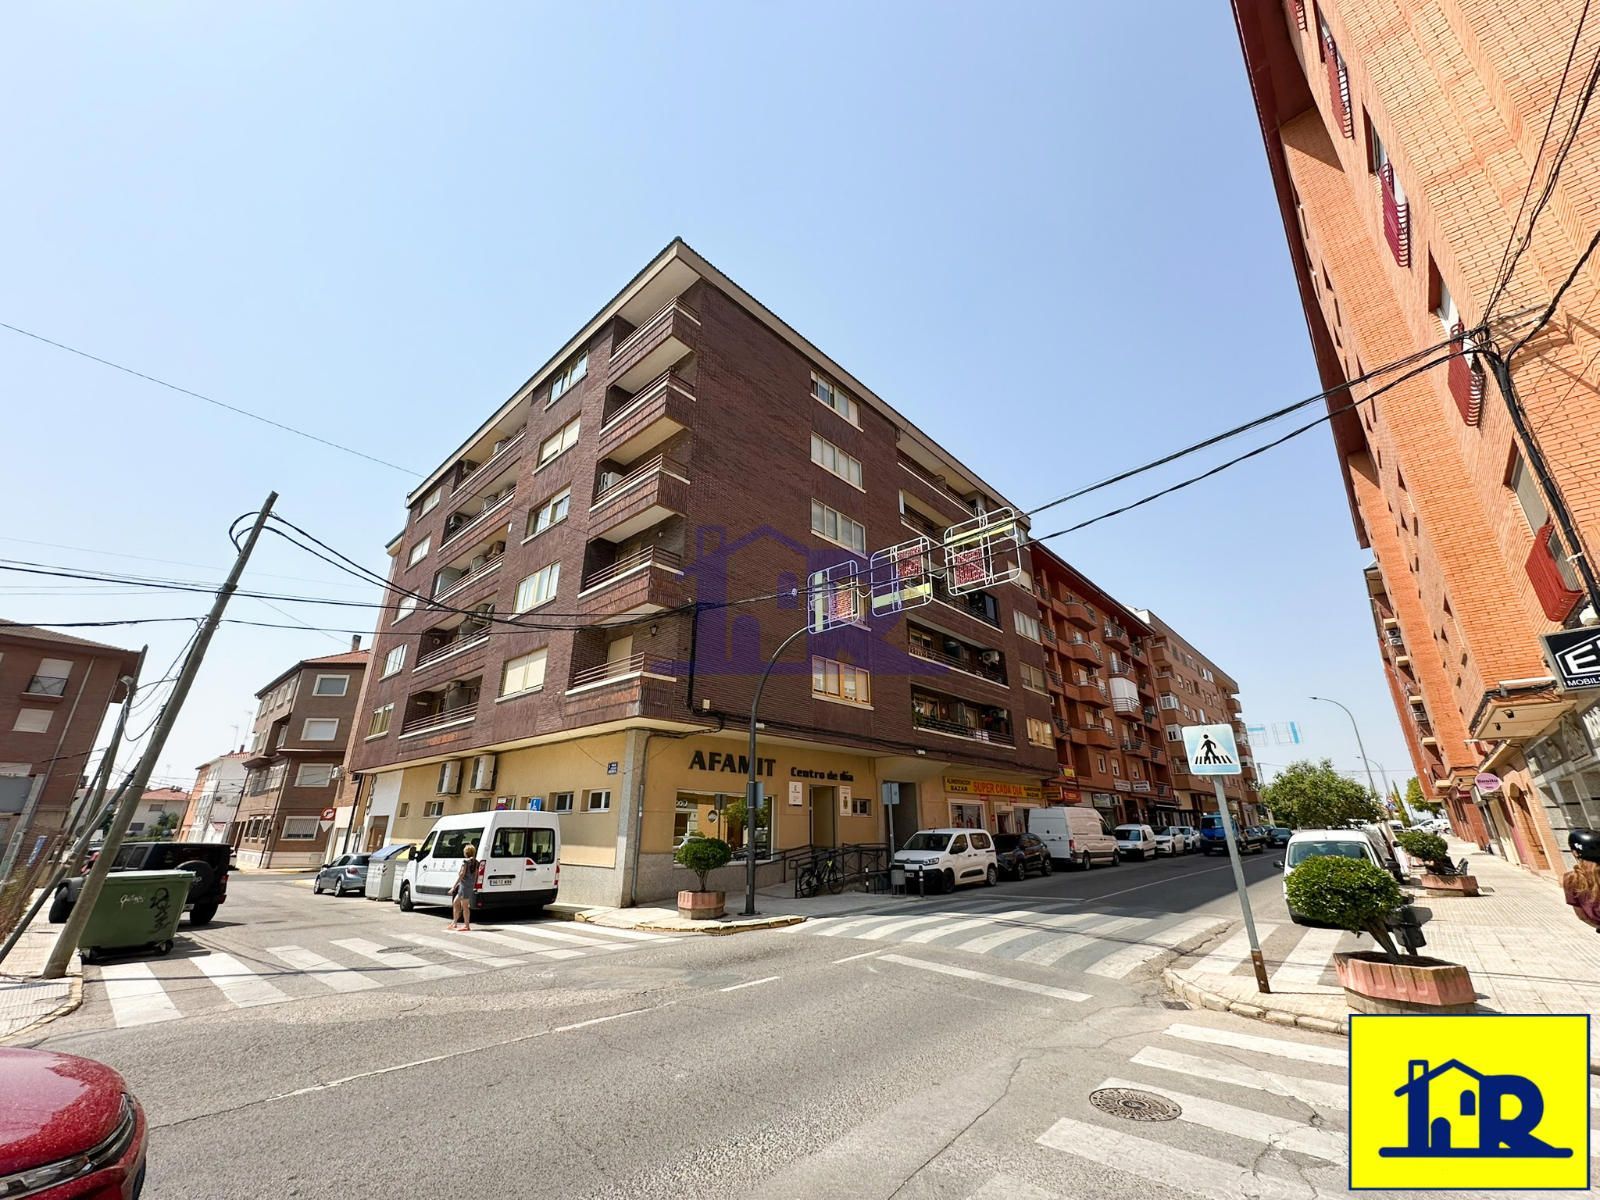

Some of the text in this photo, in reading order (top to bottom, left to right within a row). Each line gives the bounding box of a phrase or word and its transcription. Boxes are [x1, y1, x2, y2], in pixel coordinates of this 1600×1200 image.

[1566, 677, 1600, 687] MOBIL
[688, 750, 776, 777] AFAMIT
[790, 766, 825, 779] Centro
[827, 770, 838, 780] de
[972, 782, 995, 793] SUPER
